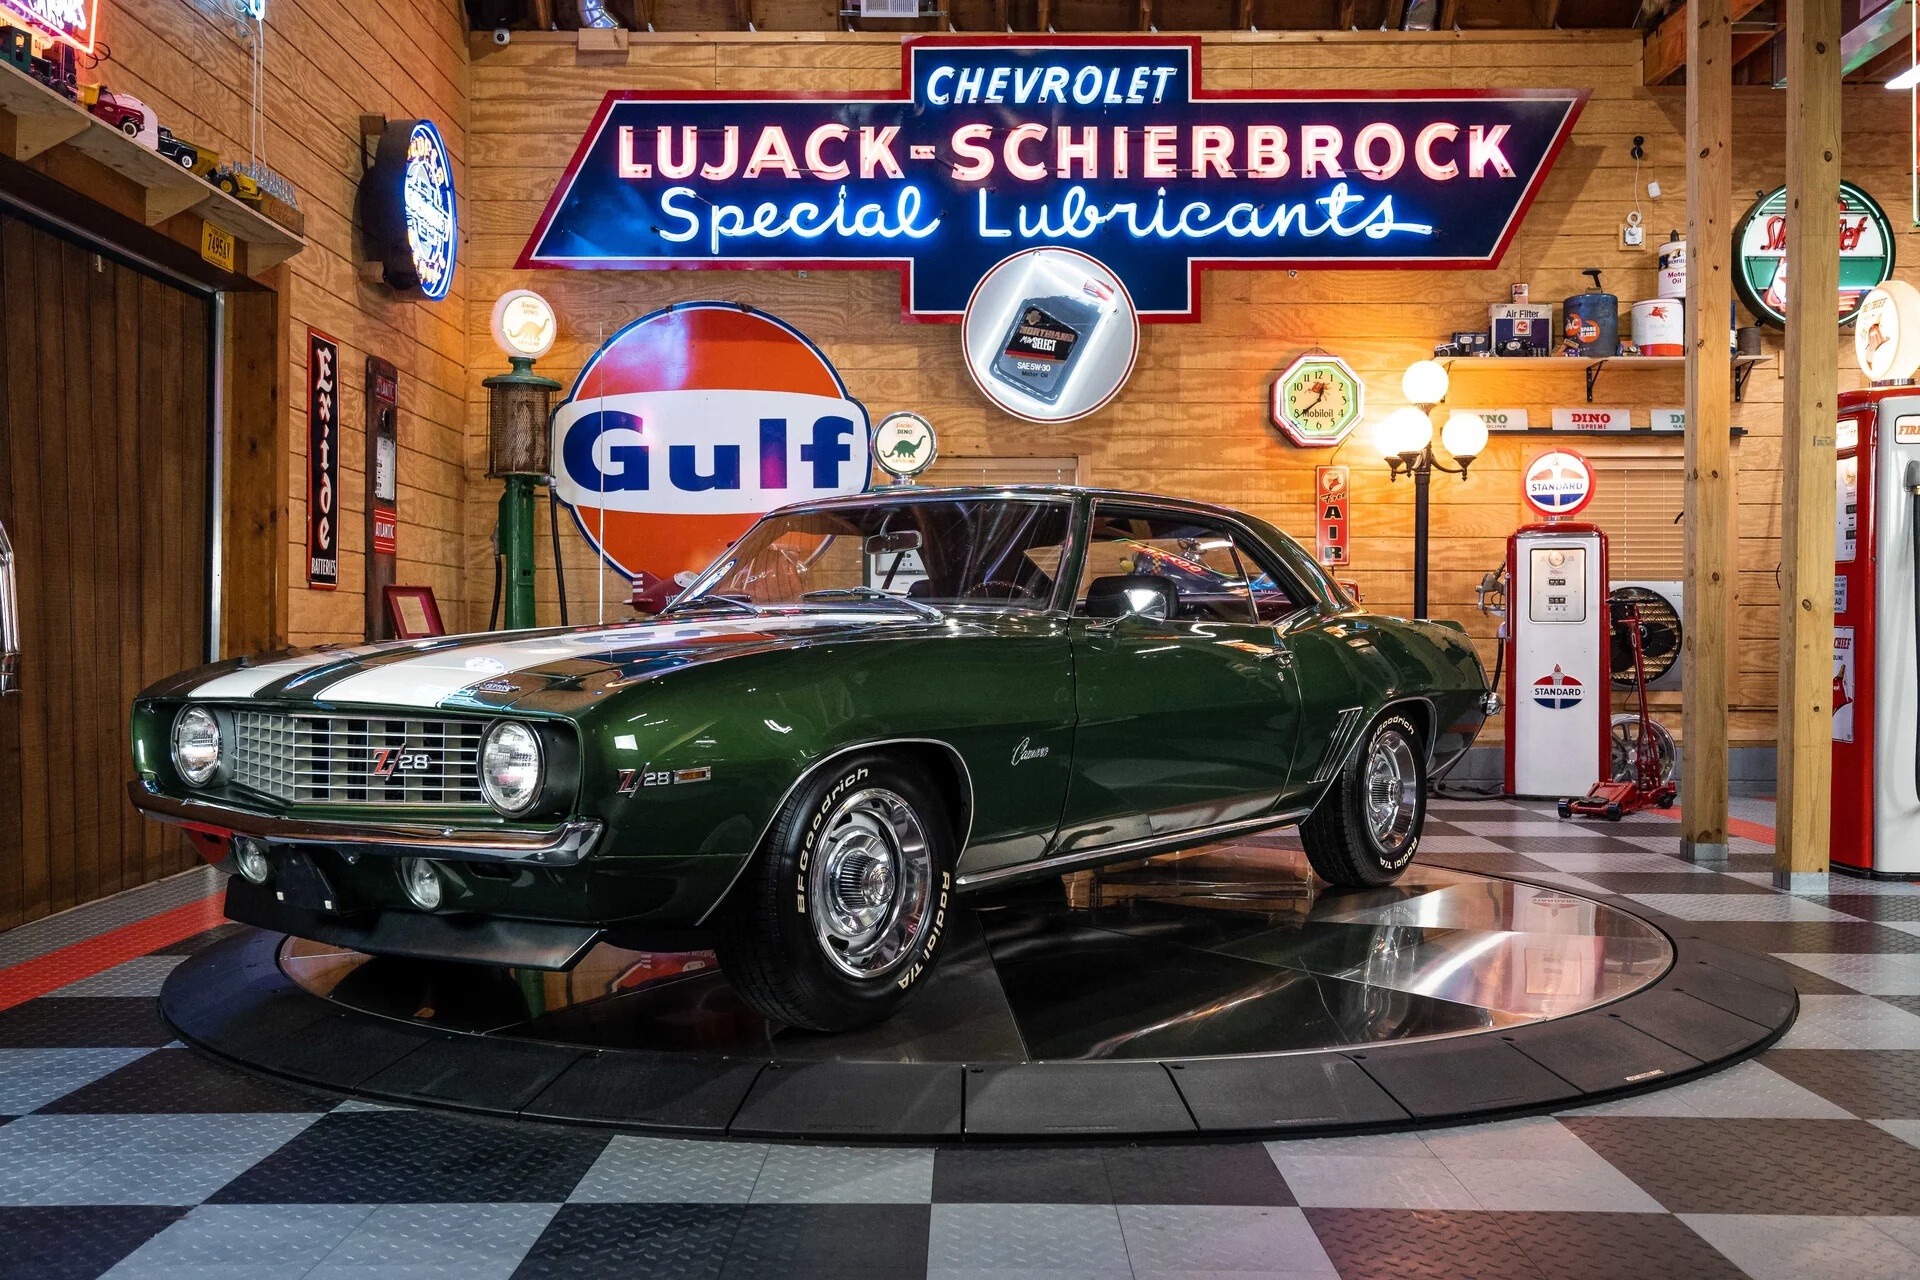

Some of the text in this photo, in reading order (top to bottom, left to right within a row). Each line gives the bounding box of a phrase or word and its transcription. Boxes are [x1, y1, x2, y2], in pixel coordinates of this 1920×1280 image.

[926, 65, 1177, 104] CHEVROLET
[618, 123, 1517, 181] LUJACK-SCHIERBROCK
[655, 183, 1436, 254] Special Lubricants
[1506, 309, 1539, 318] Air Filter
[1565, 317, 1579, 331] AC
[1017, 362, 1030, 370] SAE
[1304, 374, 1310, 382] 11
[1315, 371, 1323, 380] 12
[1330, 374, 1334, 382] 1
[1294, 383, 1303, 391] 10
[1339, 383, 1344, 391] 2
[1291, 395, 1297, 404] 9
[1341, 396, 1347, 405] 3
[1294, 409, 1300, 419] 8
[1303, 409, 1334, 418] Mobiloil
[1338, 409, 1344, 417] 4
[1304, 419, 1309, 428] 7
[1331, 418, 1336, 427] 5
[1571, 413, 1611, 424] DINO
[1316, 421, 1322, 430] 6
[1898, 425, 1920, 435] FIR
[562, 410, 854, 493] Gulf
[1531, 481, 1583, 492] STANDARD
[1320, 492, 1347, 504] Free
[1323, 505, 1343, 560] AIR
[312, 556, 336, 577] BATTERIES
[1534, 687, 1581, 696] STANDARD
[373, 743, 431, 781] Z/28
[616, 762, 670, 798] Z/28
[1394, 836, 1418, 869] Radial
[898, 871, 950, 989] Radial T/A
